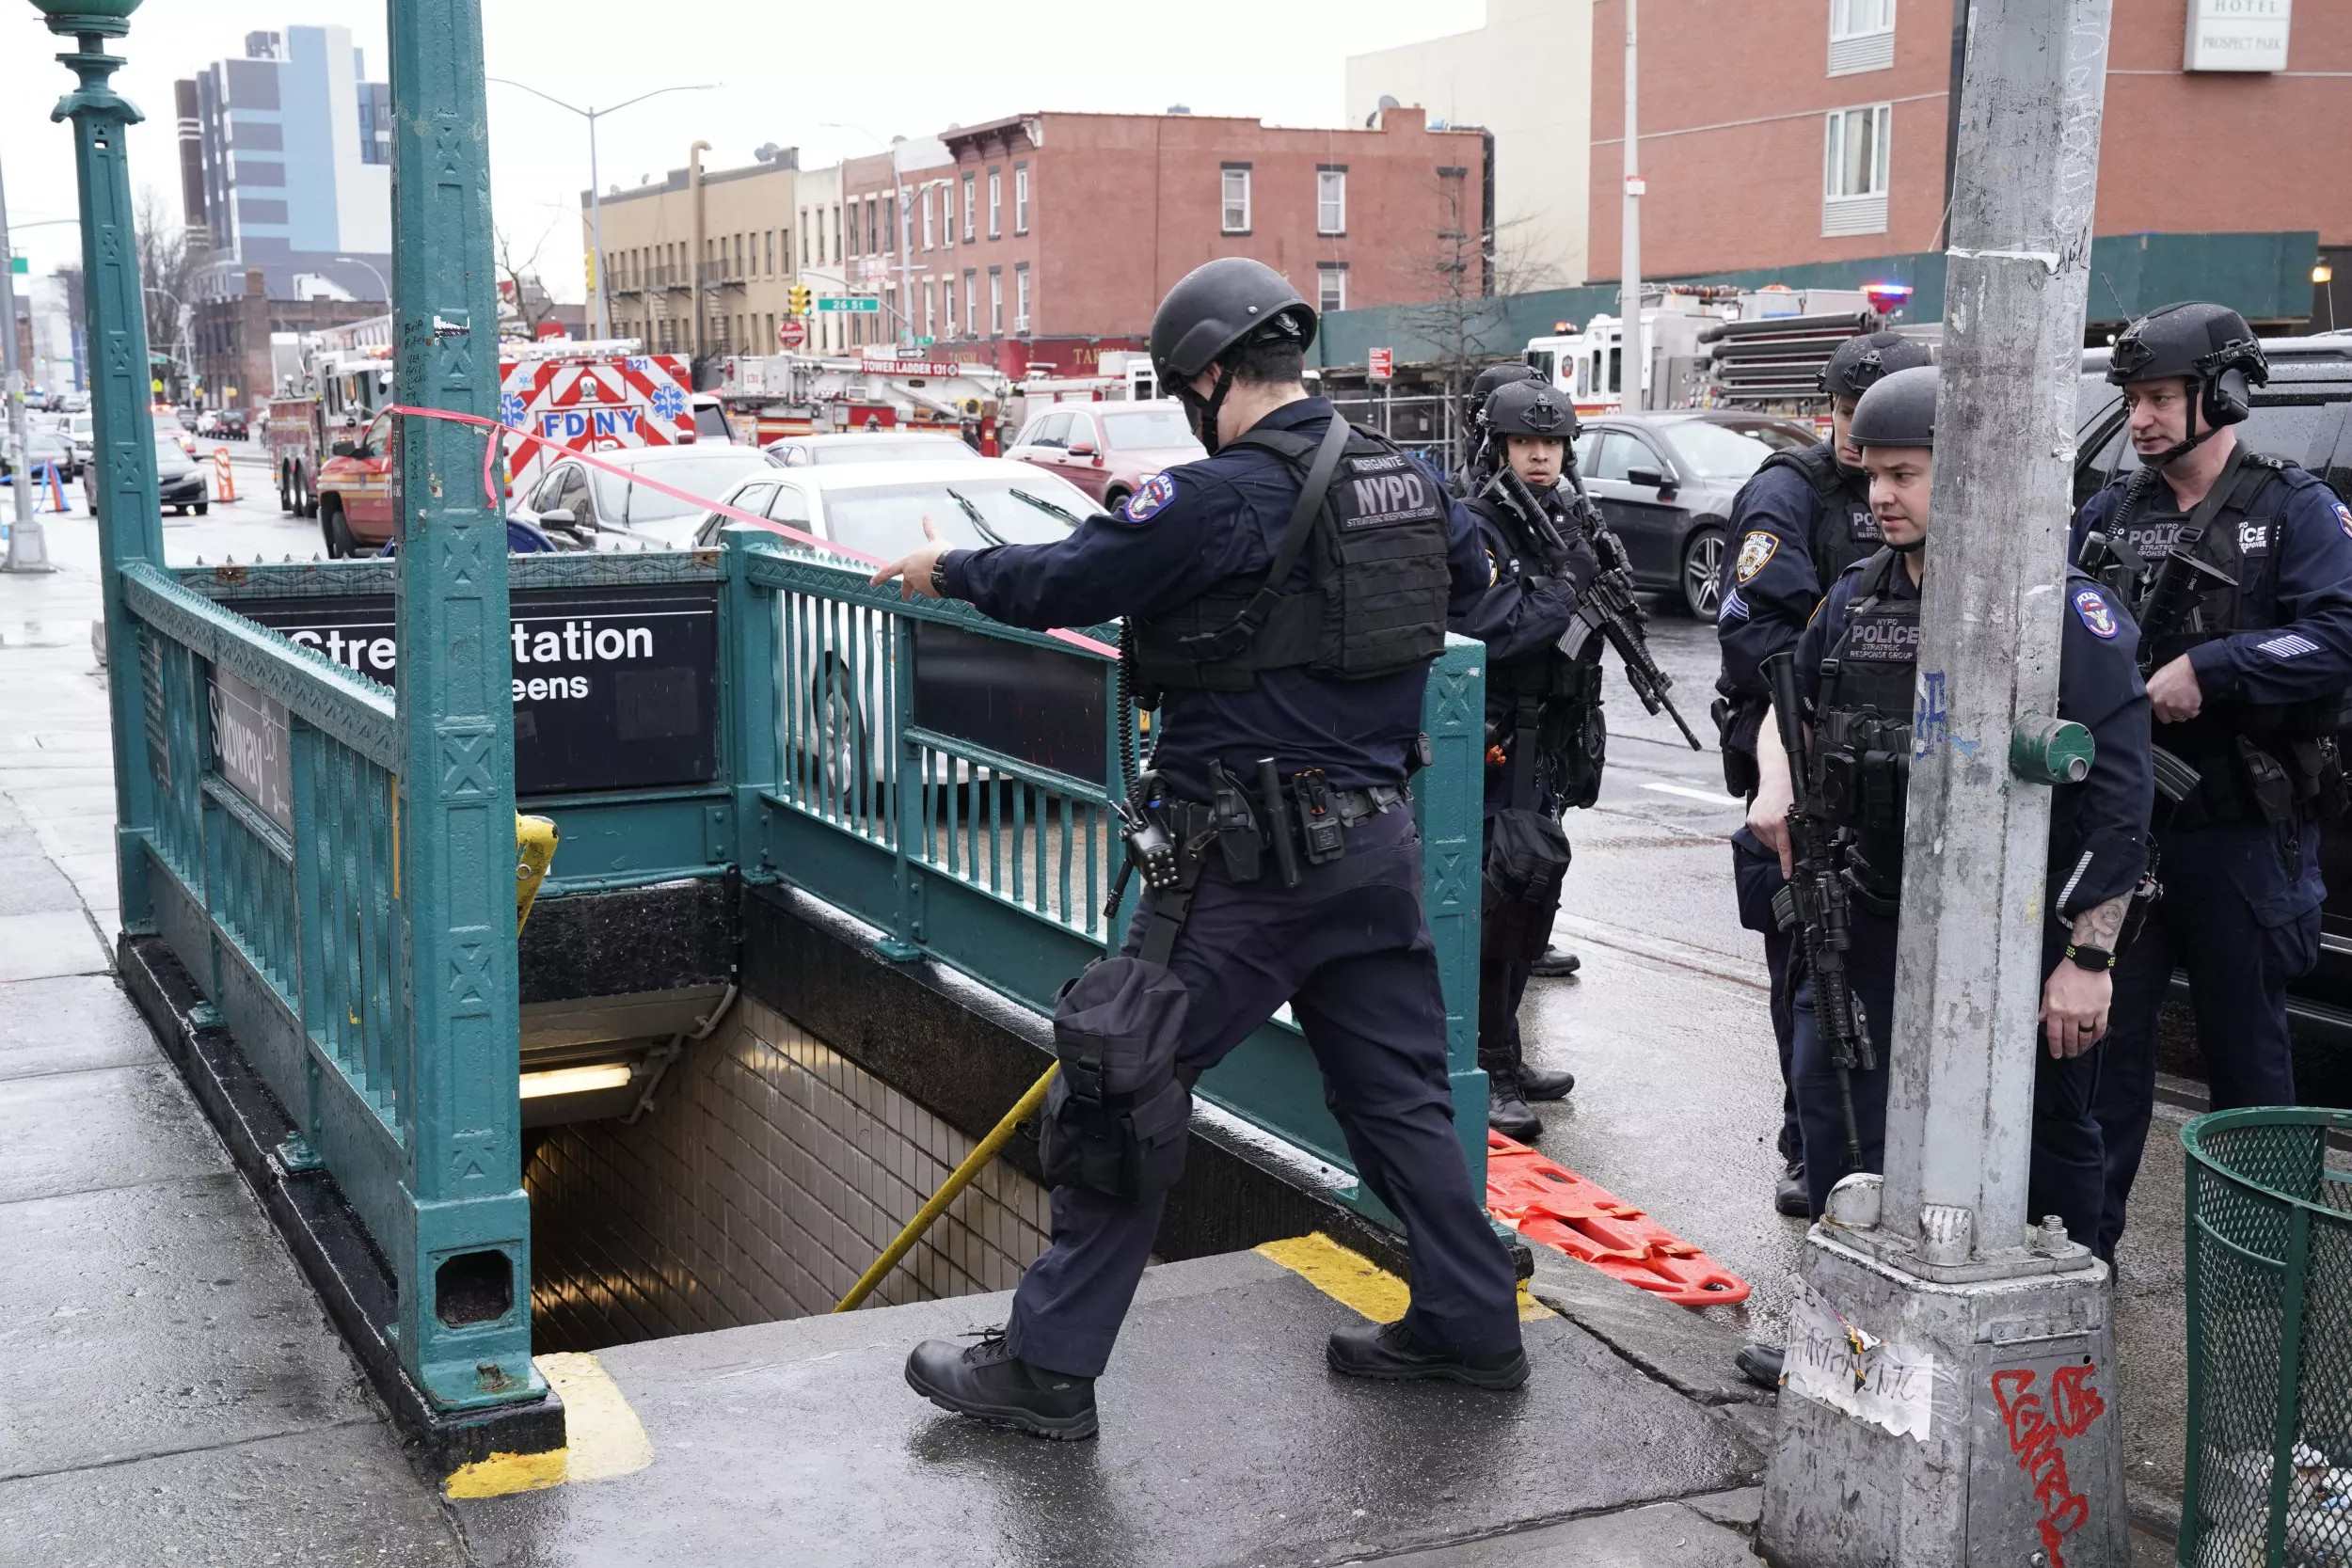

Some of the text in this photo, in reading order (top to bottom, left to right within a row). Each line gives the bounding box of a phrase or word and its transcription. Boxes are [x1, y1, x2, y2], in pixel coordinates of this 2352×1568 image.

[2202, 36, 2281, 50] PROSPECT PARK
[833, 300, 865, 309] 26 St
[626, 359, 648, 371] 921
[863, 361, 947, 375] TOWER LADDER 131
[544, 409, 639, 437] FDNY
[1353, 473, 1425, 515] NYPD
[1383, 510, 1417, 523] RESPONSE
[2238, 526, 2267, 543] ICE
[2238, 541, 2267, 550] ESPONSE
[1851, 625, 1919, 644] POLICE
[291, 621, 653, 670] Stre tation
[1862, 643, 1900, 652] STRATEGIC
[1850, 650, 1887, 658] RESPONSE
[512, 676, 589, 702] eens
[209, 686, 263, 806] Subway
